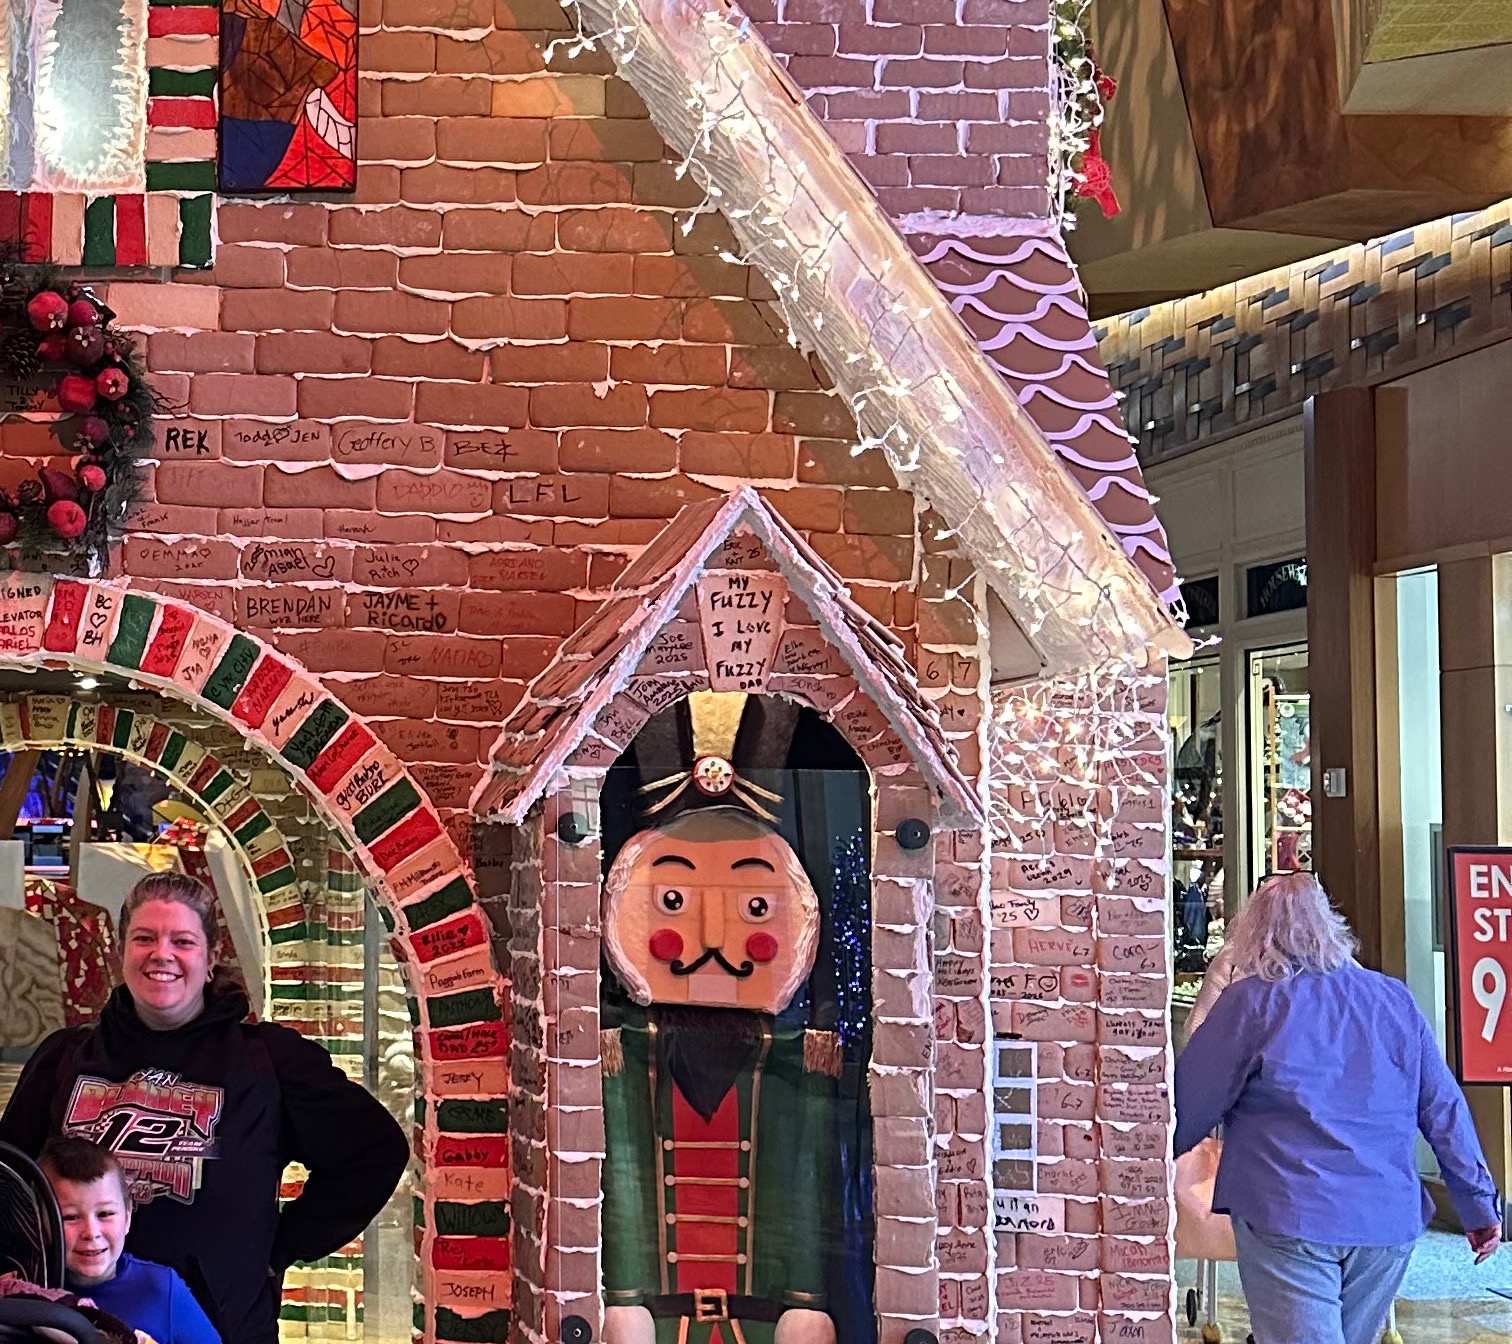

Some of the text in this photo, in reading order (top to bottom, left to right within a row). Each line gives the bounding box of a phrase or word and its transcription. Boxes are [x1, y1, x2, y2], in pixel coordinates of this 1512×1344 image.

[729, 576, 749, 589] MY
[247, 595, 332, 619] BRENDAN
[363, 593, 420, 611] JAYME
[712, 622, 724, 637] I
[731, 639, 752, 653] MY
[926, 659, 972, 681] 6 7
[96, 1110, 185, 1155] 12
[444, 1172, 485, 1193] Kate
